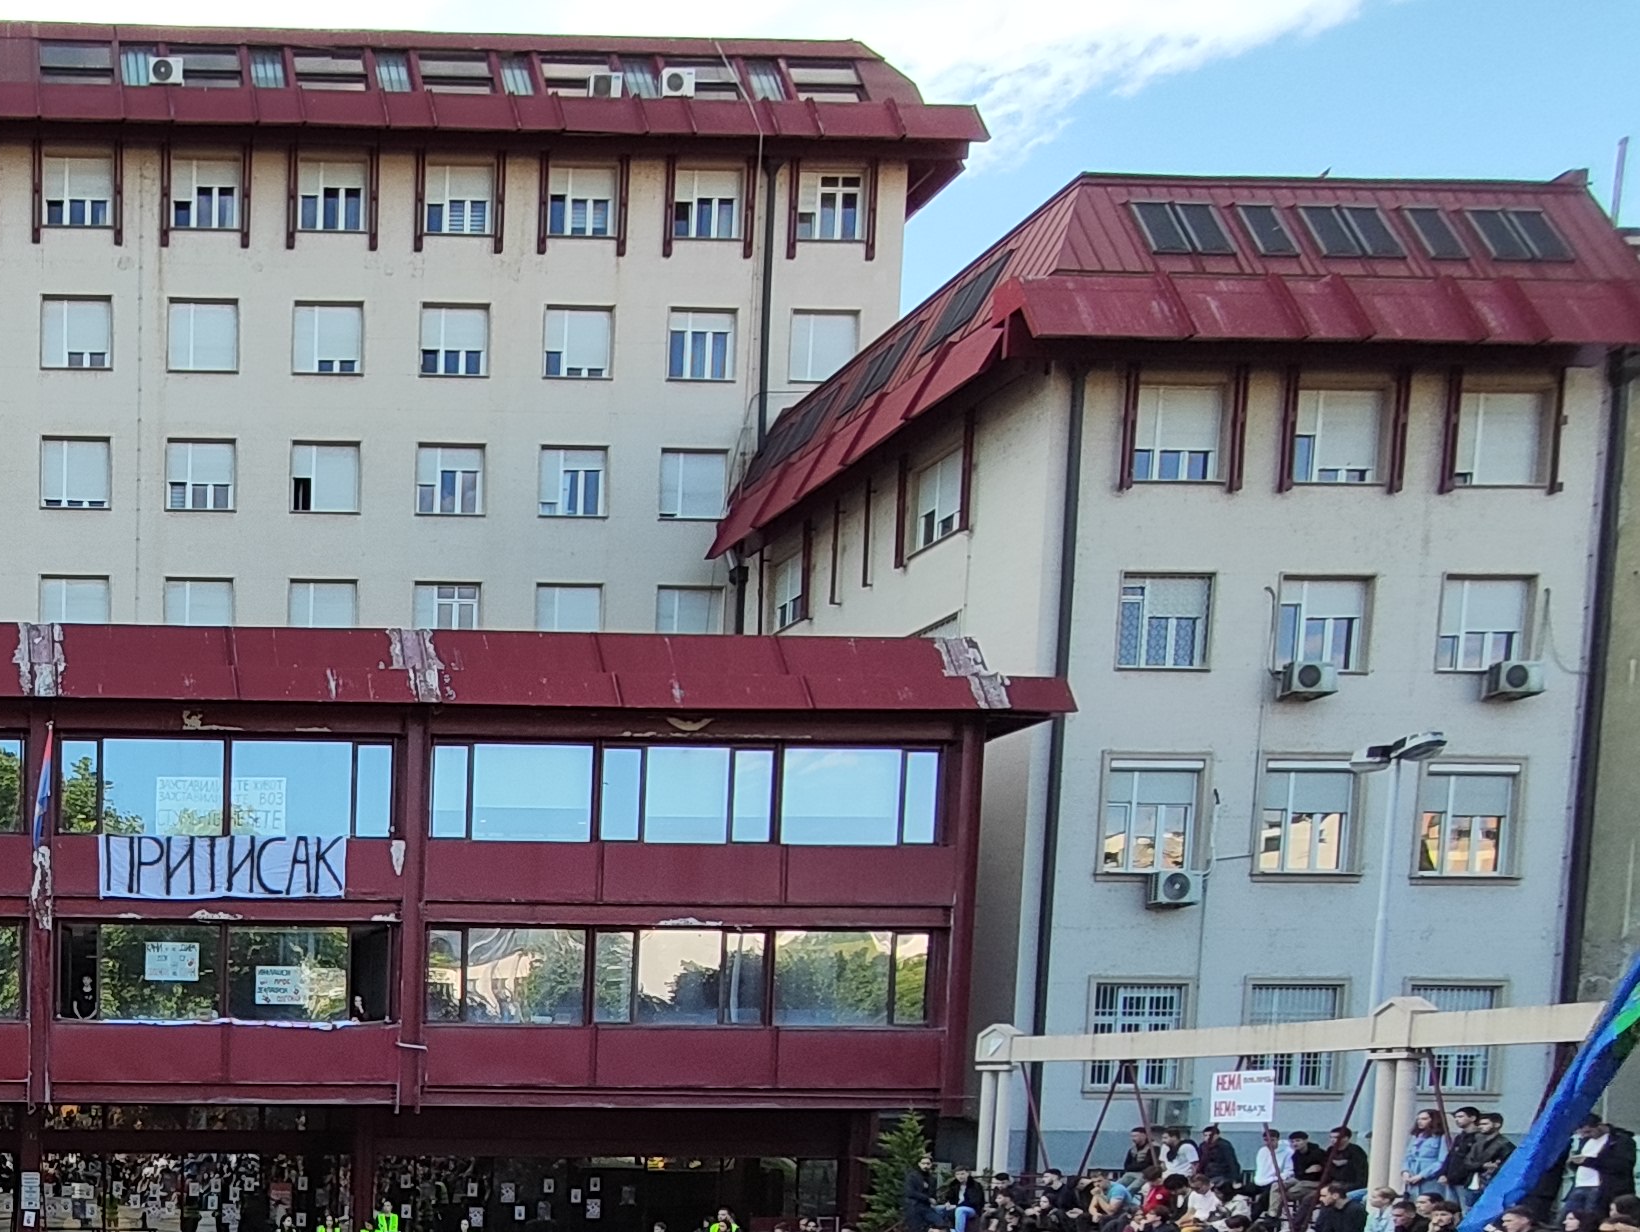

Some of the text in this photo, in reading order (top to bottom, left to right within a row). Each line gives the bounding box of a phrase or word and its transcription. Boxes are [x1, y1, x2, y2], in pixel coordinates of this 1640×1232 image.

[105, 835, 343, 896] ПРИТИСАК
[1216, 1073, 1242, 1092] НЕМА
[1213, 1100, 1236, 1117] НЕМА
